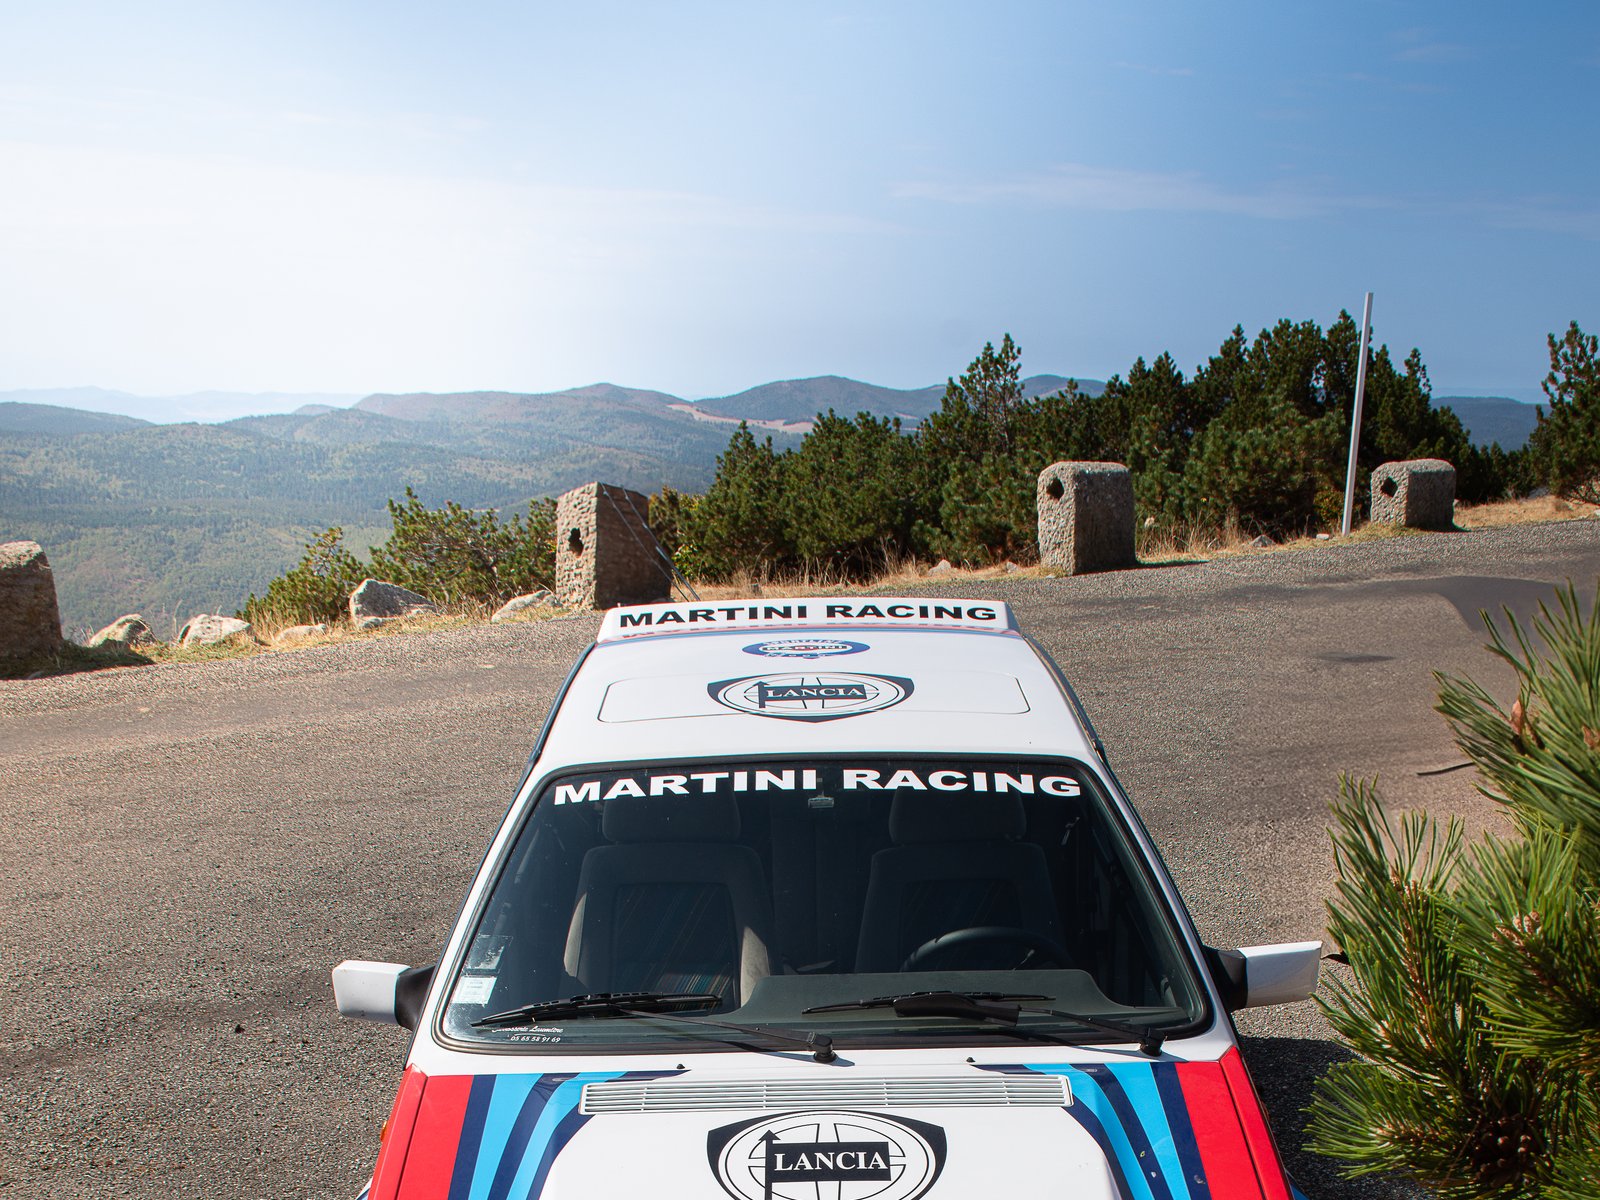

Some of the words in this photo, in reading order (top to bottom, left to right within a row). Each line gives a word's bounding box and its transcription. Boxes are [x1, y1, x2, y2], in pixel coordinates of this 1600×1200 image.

[620, 605, 807, 628] MARTINI
[826, 604, 997, 621] RACING
[766, 688, 865, 698] LANCIA
[554, 769, 817, 806] MARTINI
[843, 769, 1082, 797] RACING
[774, 1151, 889, 1171] LANCIA
